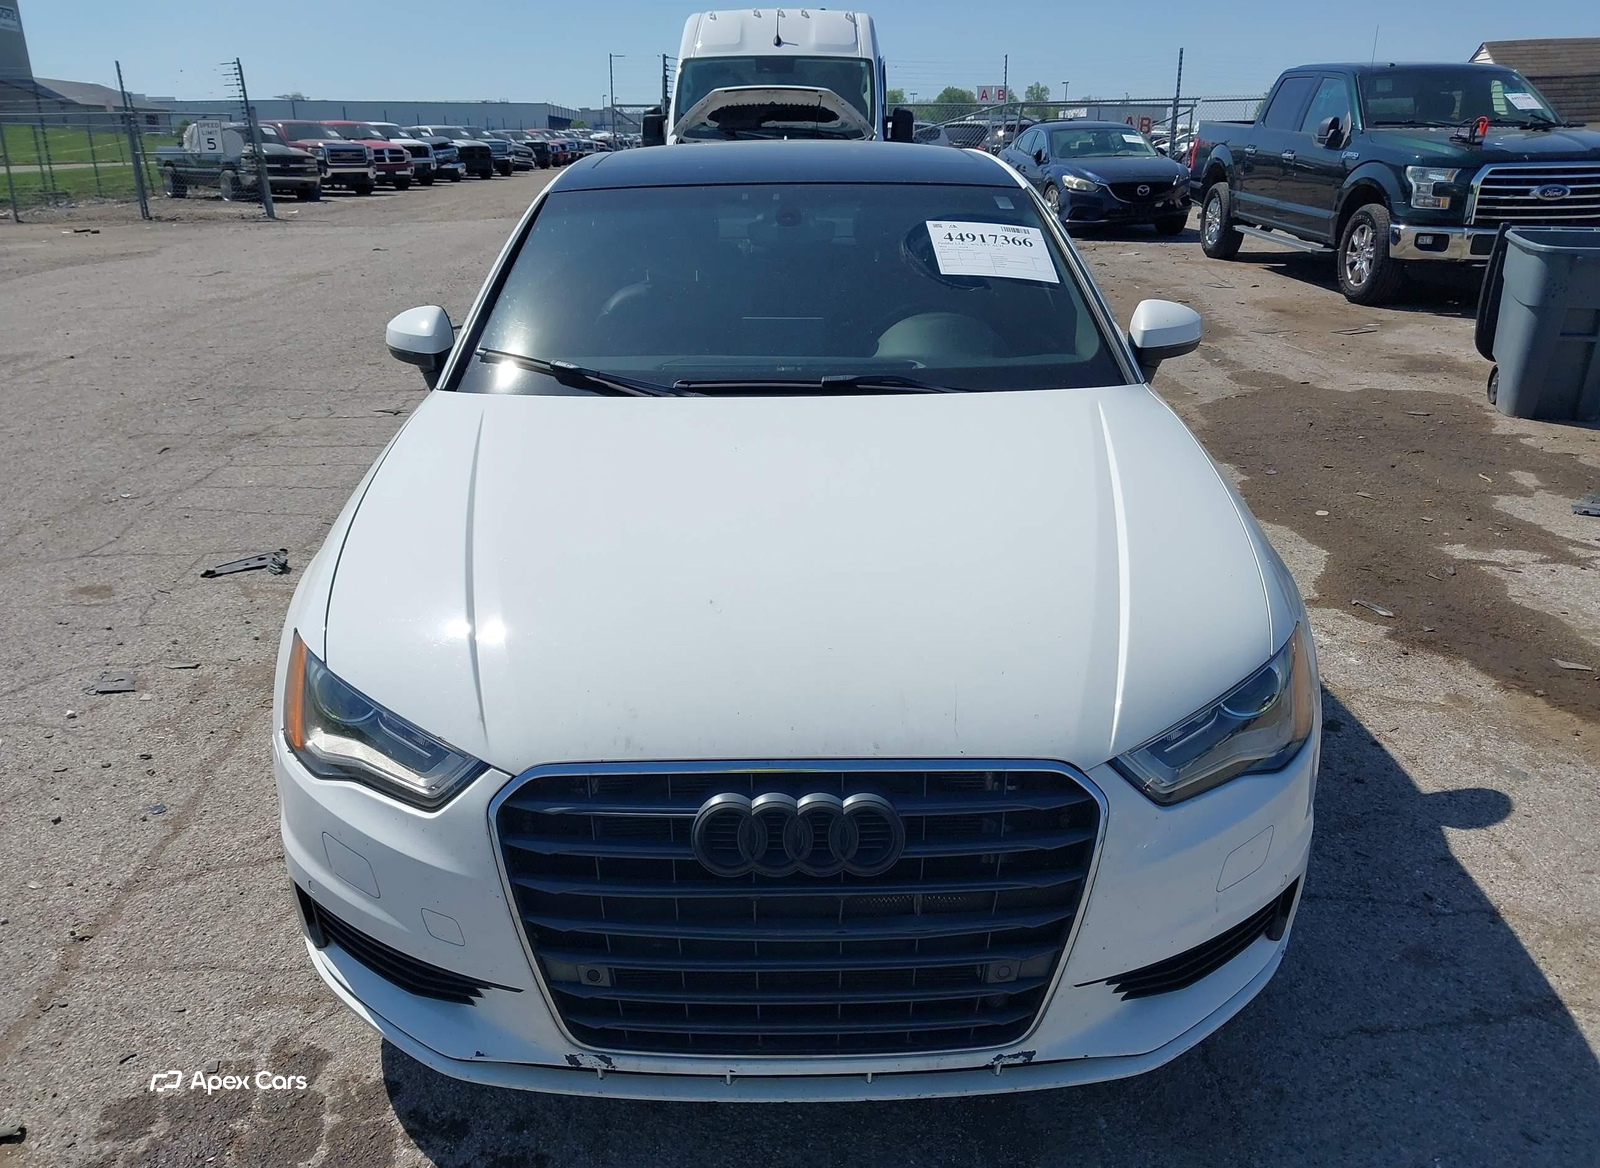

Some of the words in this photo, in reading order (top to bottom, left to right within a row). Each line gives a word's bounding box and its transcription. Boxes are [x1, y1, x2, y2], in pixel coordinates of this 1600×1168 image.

[980, 89, 989, 101] A
[997, 89, 1005, 101] B
[1140, 116, 1151, 134] B
[207, 138, 217, 150] 5
[943, 232, 1034, 248] 44917366
